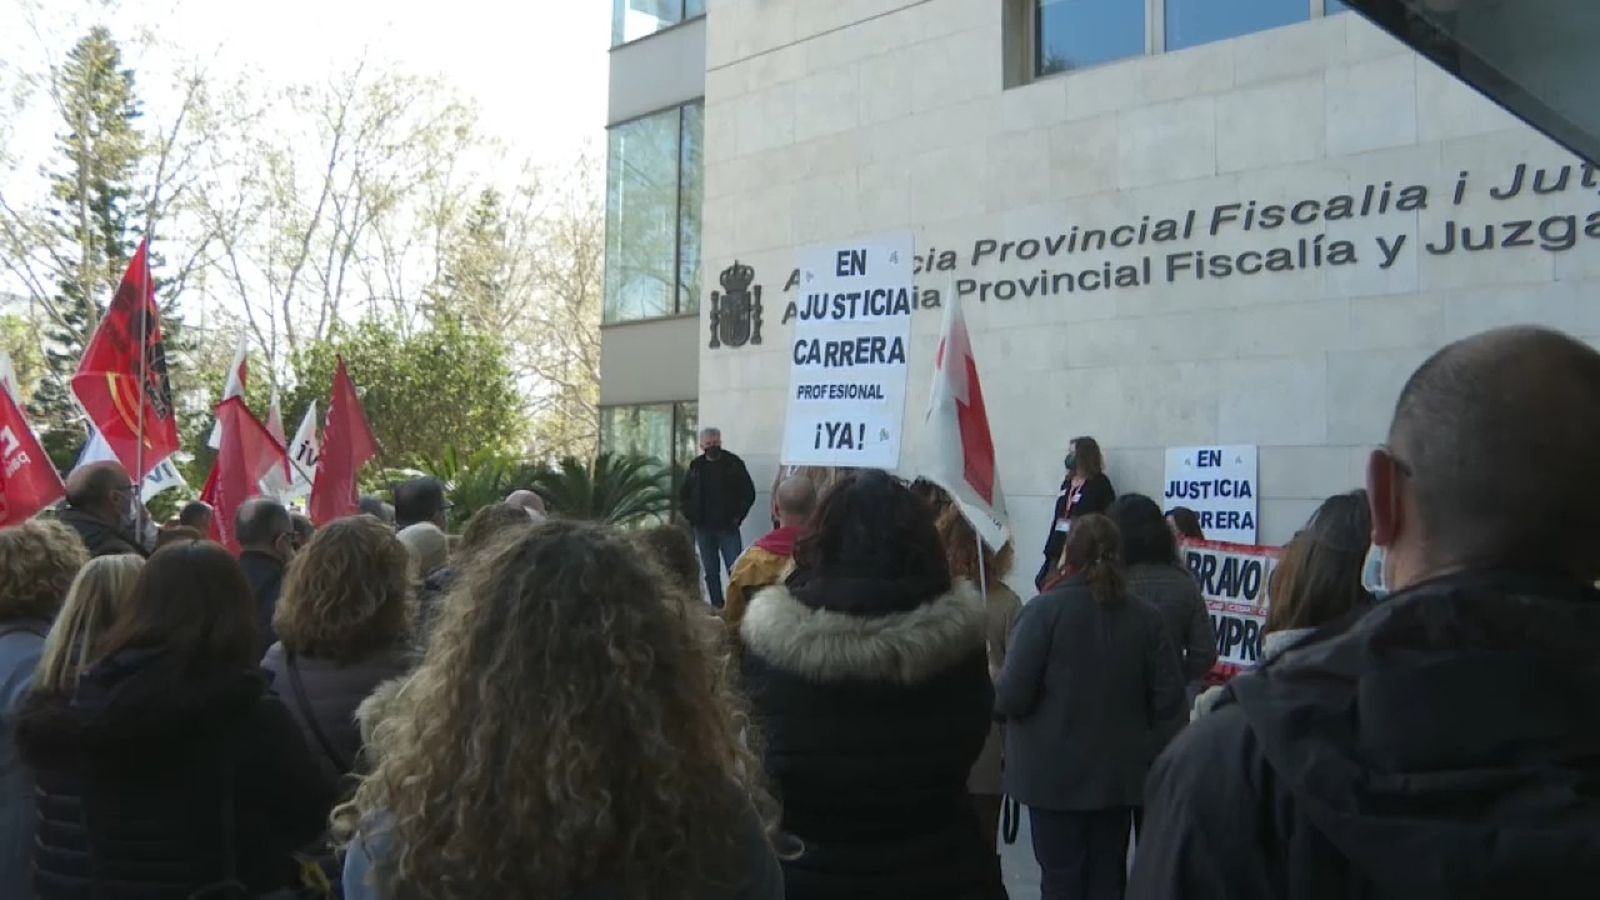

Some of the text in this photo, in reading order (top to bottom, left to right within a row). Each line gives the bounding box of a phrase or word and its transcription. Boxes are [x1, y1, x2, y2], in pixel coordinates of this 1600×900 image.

[971, 161, 1600, 266] Provincial Fiscalia i Jut
[836, 249, 867, 277] EN
[956, 256, 1150, 302] Provincial
[1166, 234, 1358, 283] Fiscalía
[1375, 233, 1407, 269] y
[800, 288, 911, 321] JUSTICIA
[793, 336, 906, 368] CARRERA
[797, 384, 884, 400] PROFESIONAL
[814, 421, 866, 450] ¡YA!
[1197, 449, 1222, 467] EN
[1165, 479, 1252, 499] JUSTICIA
[1200, 510, 1255, 530] RERA
[1186, 550, 1262, 601] BRAVO
